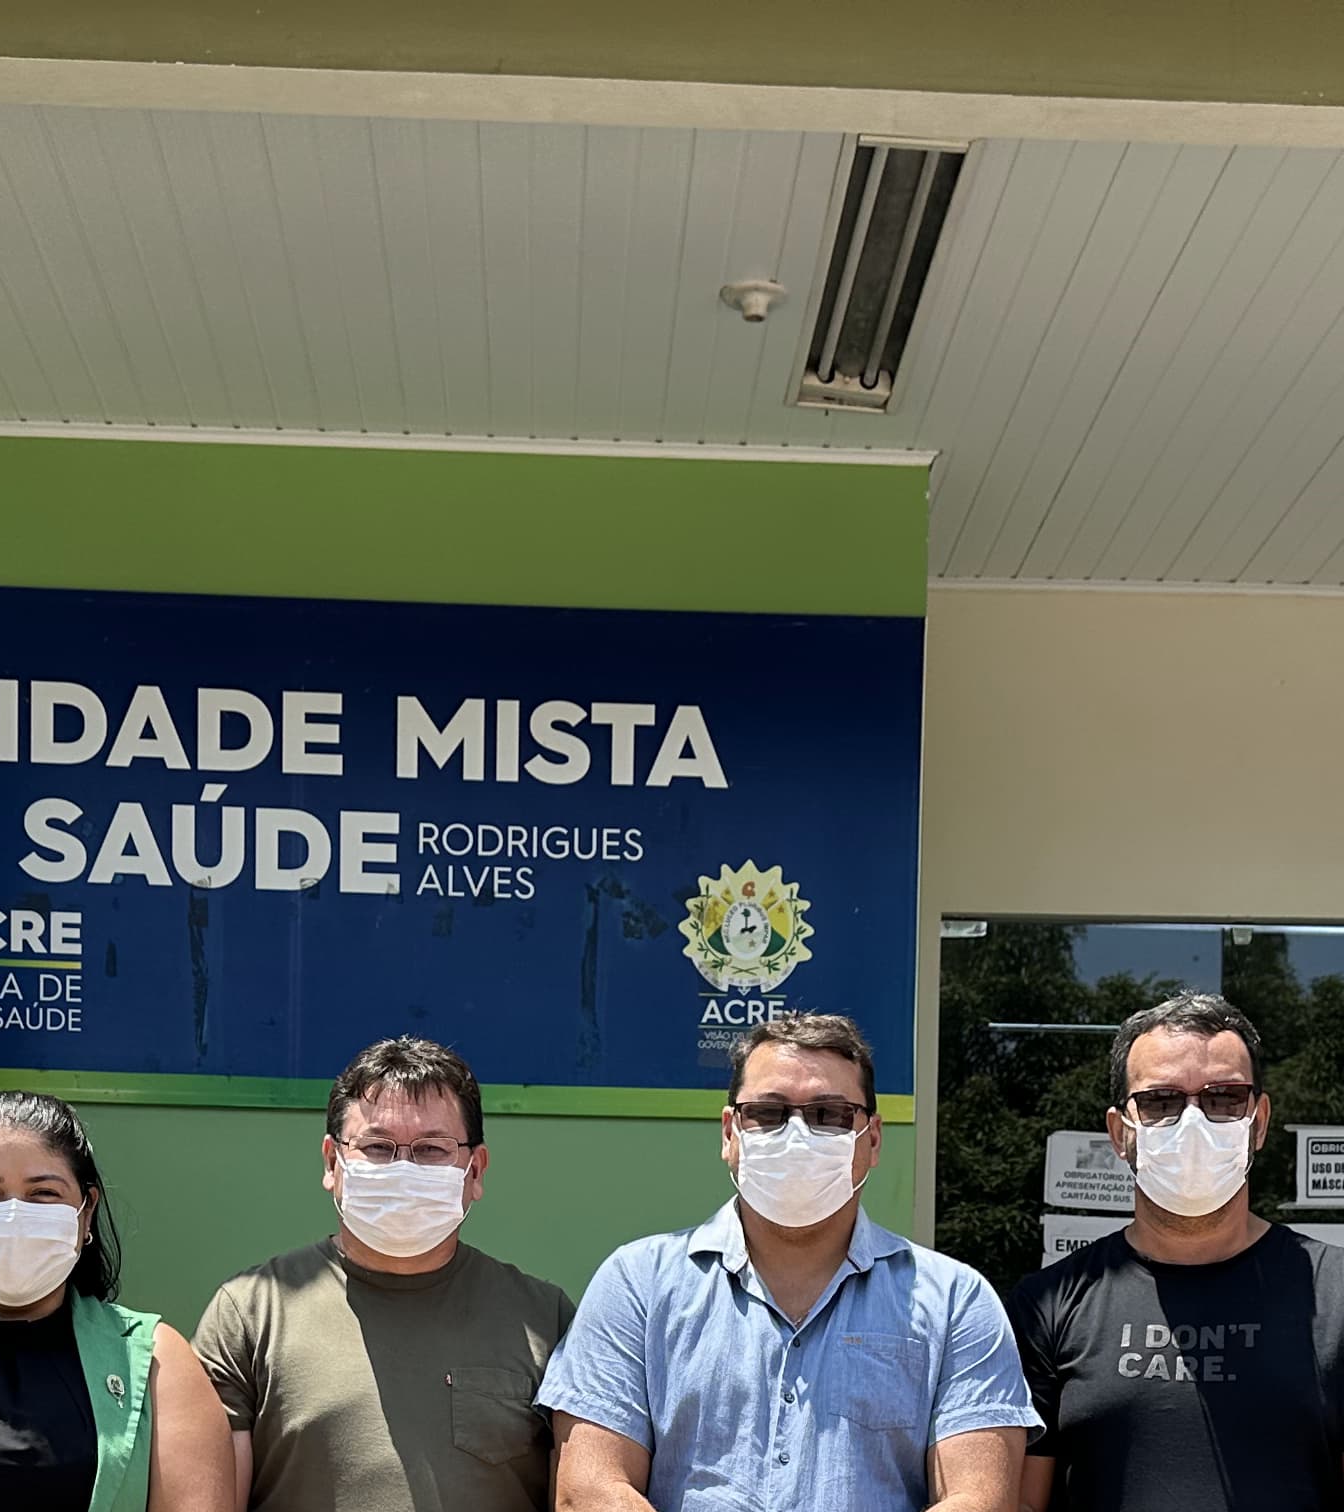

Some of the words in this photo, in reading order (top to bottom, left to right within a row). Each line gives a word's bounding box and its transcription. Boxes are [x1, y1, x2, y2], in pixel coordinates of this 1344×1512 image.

[396, 695, 729, 789] MISTA
[18, 783, 401, 895] SAÚDE
[418, 822, 644, 861] RODRIGUES
[416, 864, 535, 900] ALVES
[39, 974, 82, 1003] DE
[701, 999, 785, 1026] ACRE
[1064, 1170, 1125, 1180] OBRIGATÓRIO
[1311, 1162, 1332, 1174] USO
[1056, 1181, 1125, 1192] APRESENTAÇÃO
[1061, 1191, 1097, 1201] CARTÃO
[1098, 1192, 1112, 1202] DO
[1113, 1194, 1131, 1203] SUS
[1055, 1239, 1094, 1253] EMP
[1120, 1323, 1132, 1348] I
[1145, 1323, 1262, 1350] DON'T
[1118, 1352, 1237, 1382] CARE.
